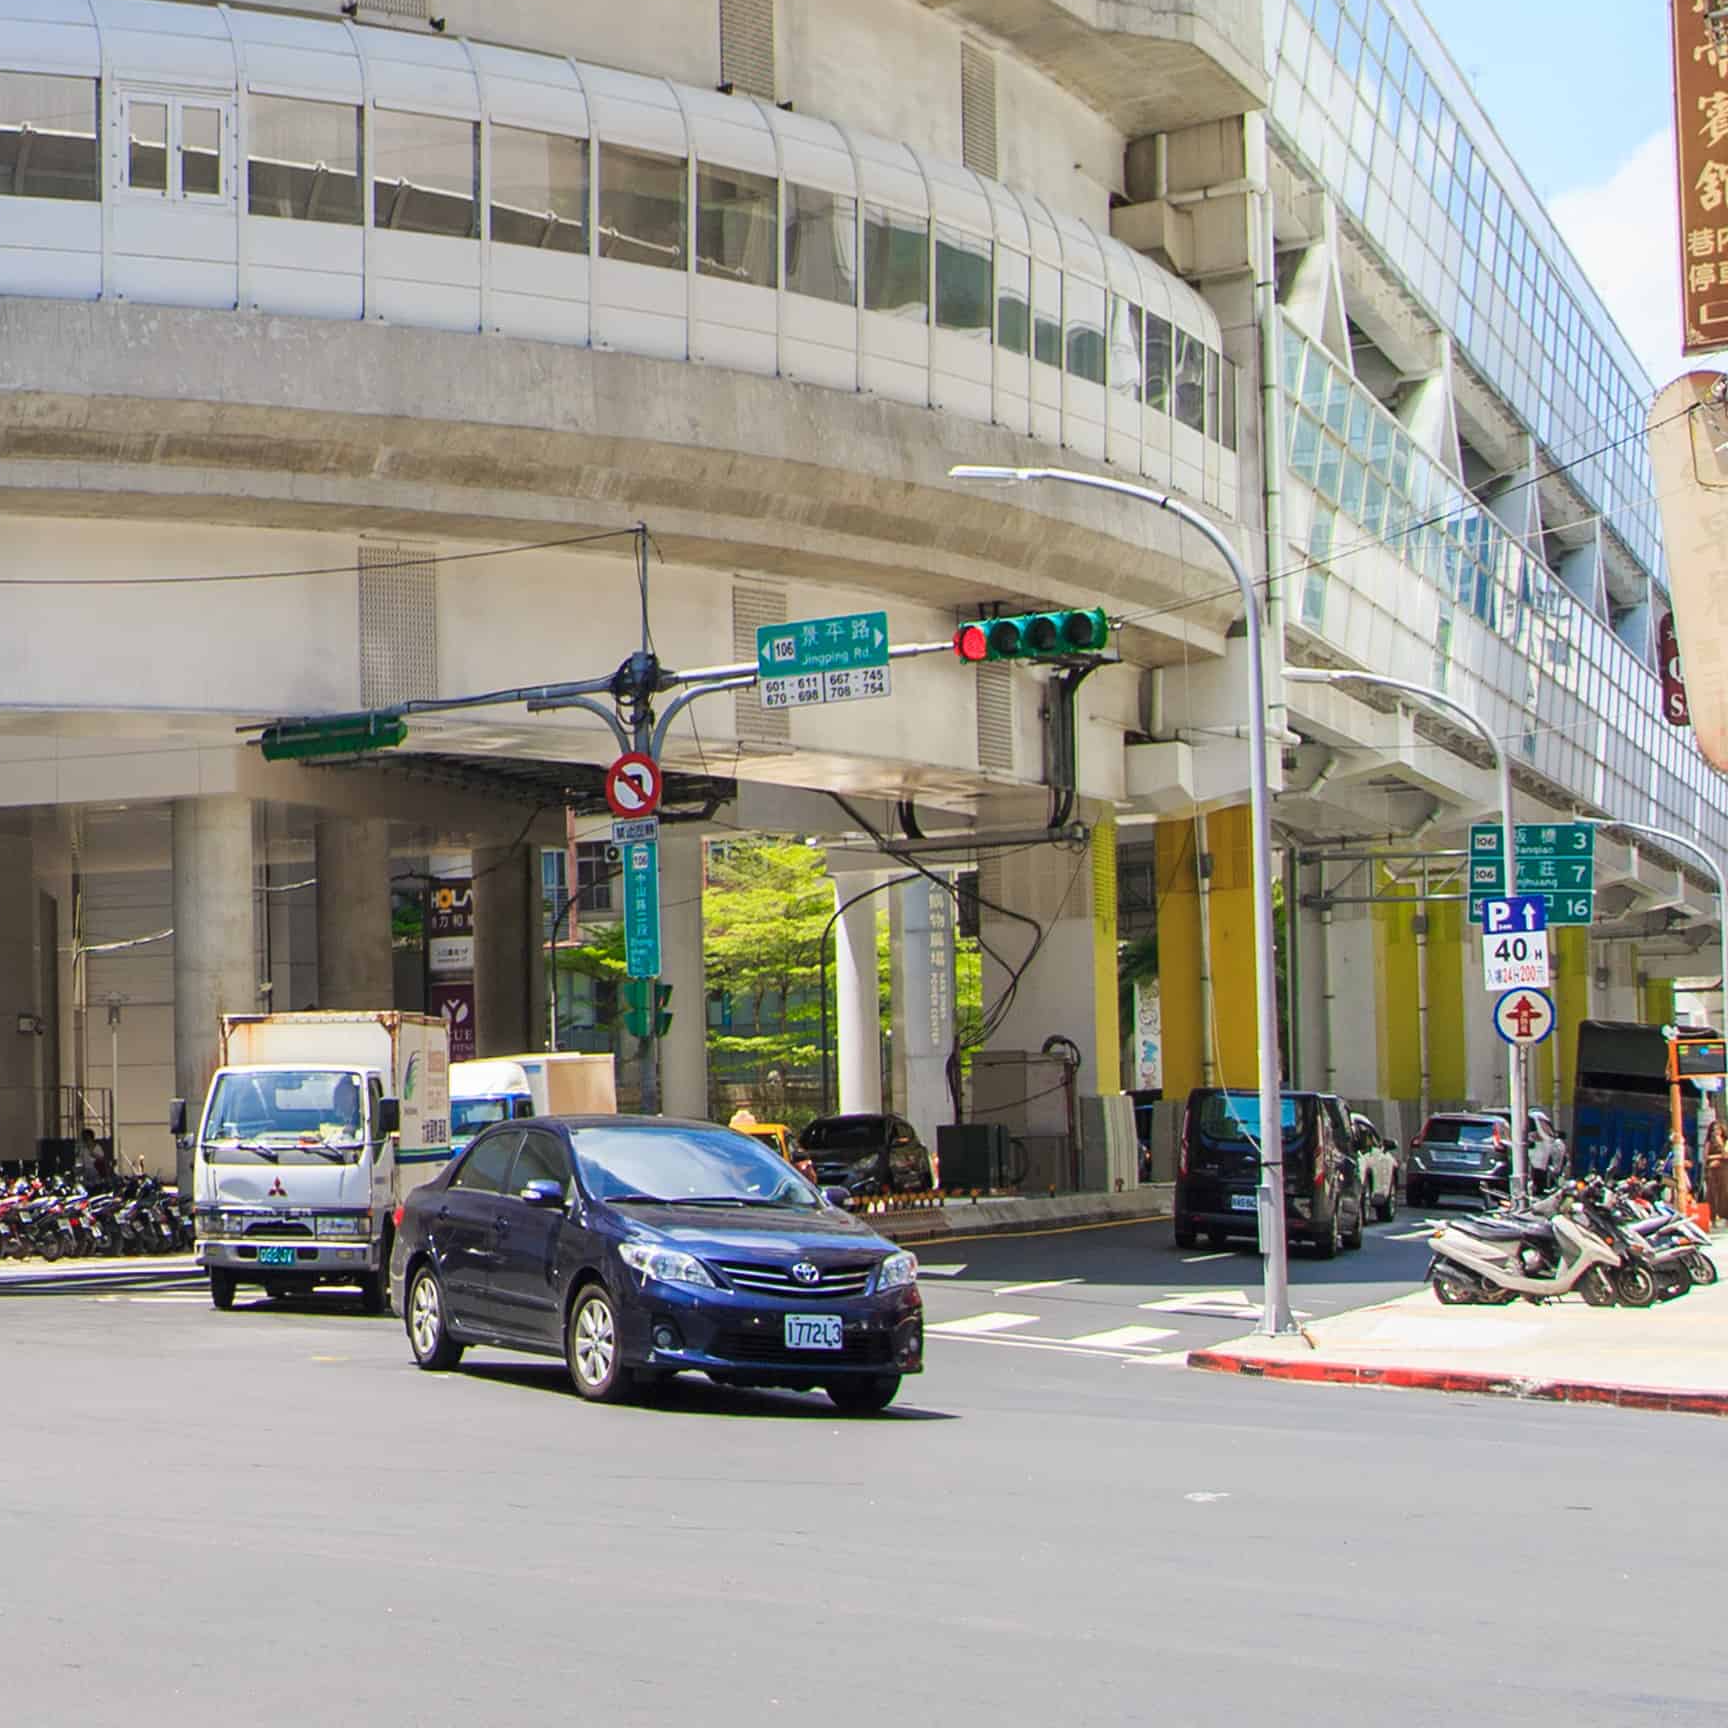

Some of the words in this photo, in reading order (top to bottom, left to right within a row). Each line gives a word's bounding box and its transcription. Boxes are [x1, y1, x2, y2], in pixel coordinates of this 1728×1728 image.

[801, 619, 870, 647] 景平路
[775, 641, 793, 657] 106
[766, 681, 785, 692] 601
[798, 677, 817, 689] 611
[1476, 838, 1495, 847] 106
[1573, 833, 1586, 849] 3
[1476, 871, 1494, 880] 106
[1572, 865, 1585, 882] 7
[431, 888, 473, 909] HOLA
[1567, 900, 1588, 915] 16
[1488, 902, 1510, 932] P
[1495, 938, 1527, 962] 40
